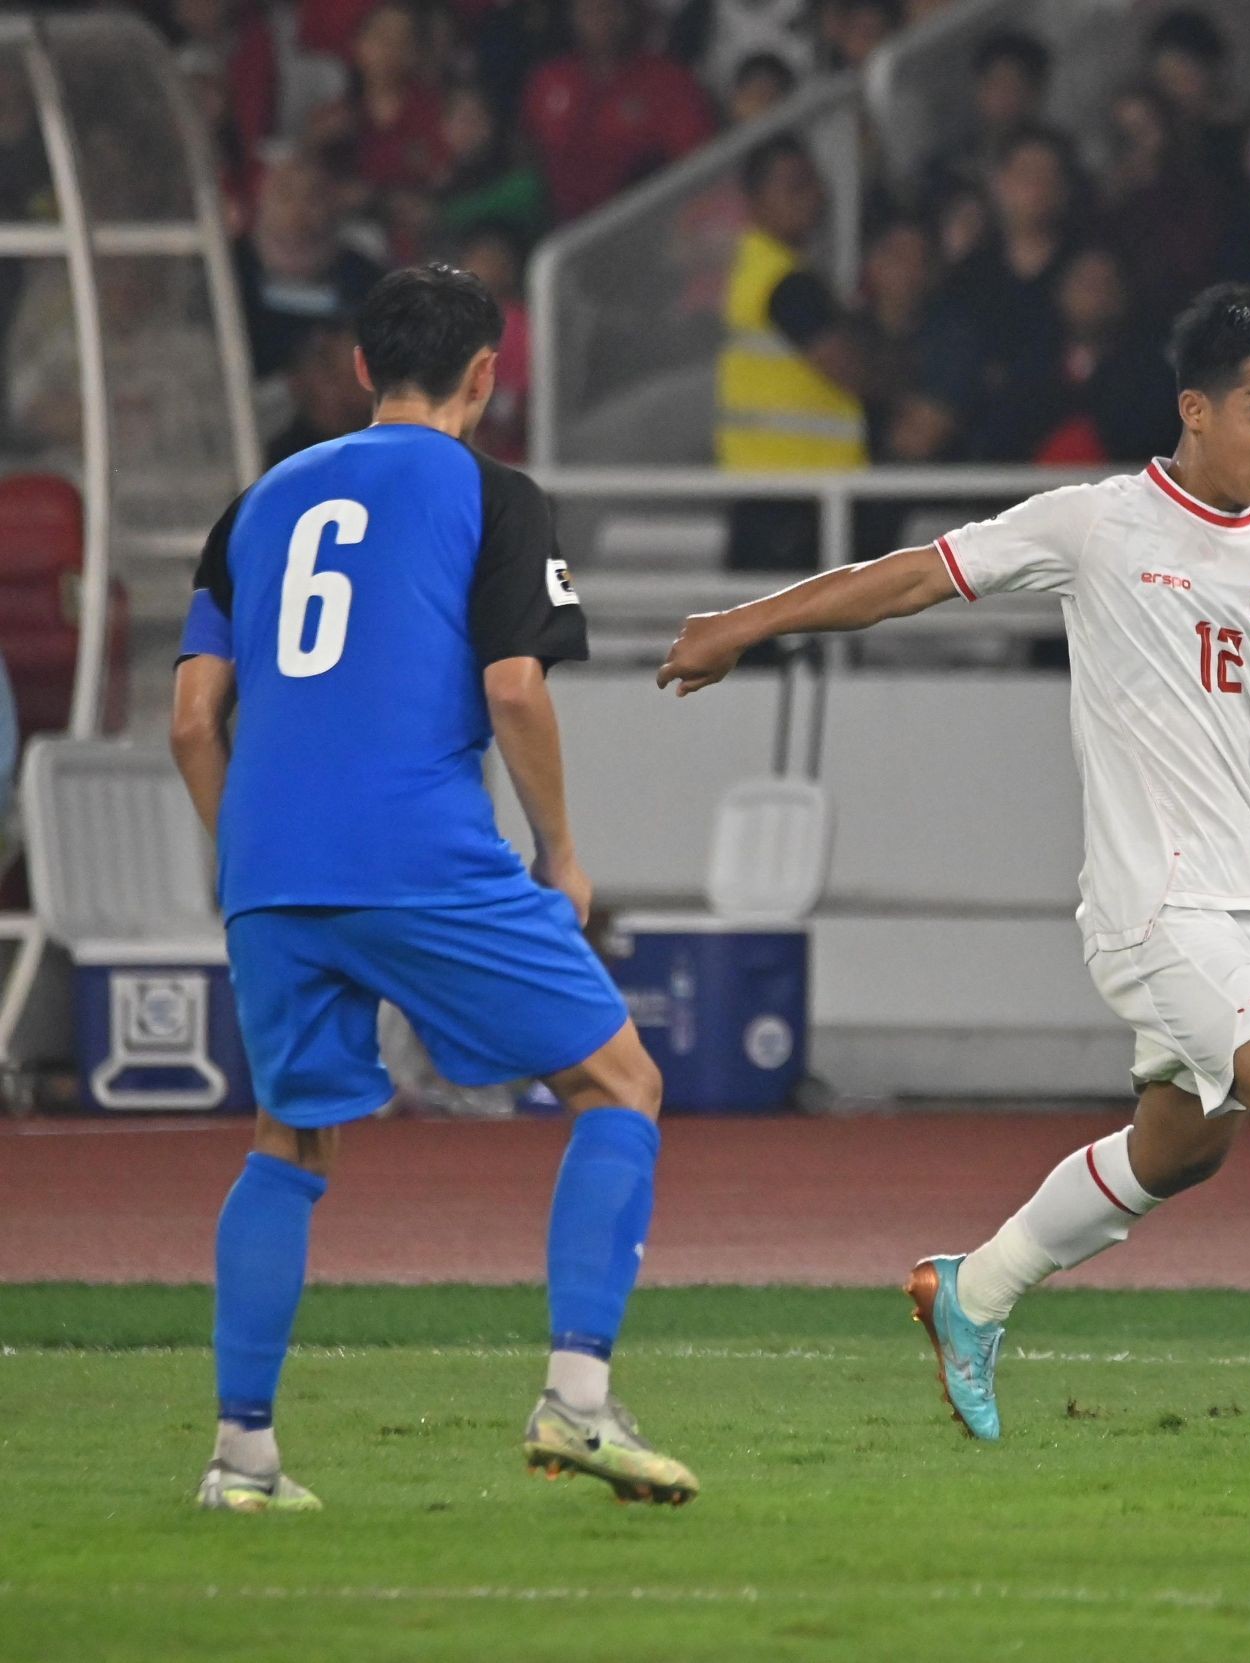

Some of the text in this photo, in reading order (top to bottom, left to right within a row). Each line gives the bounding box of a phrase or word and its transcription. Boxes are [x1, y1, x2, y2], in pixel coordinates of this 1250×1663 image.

[277, 498, 369, 678] 6
[1141, 571, 1191, 590] erspo
[1195, 620, 1244, 693] 12
